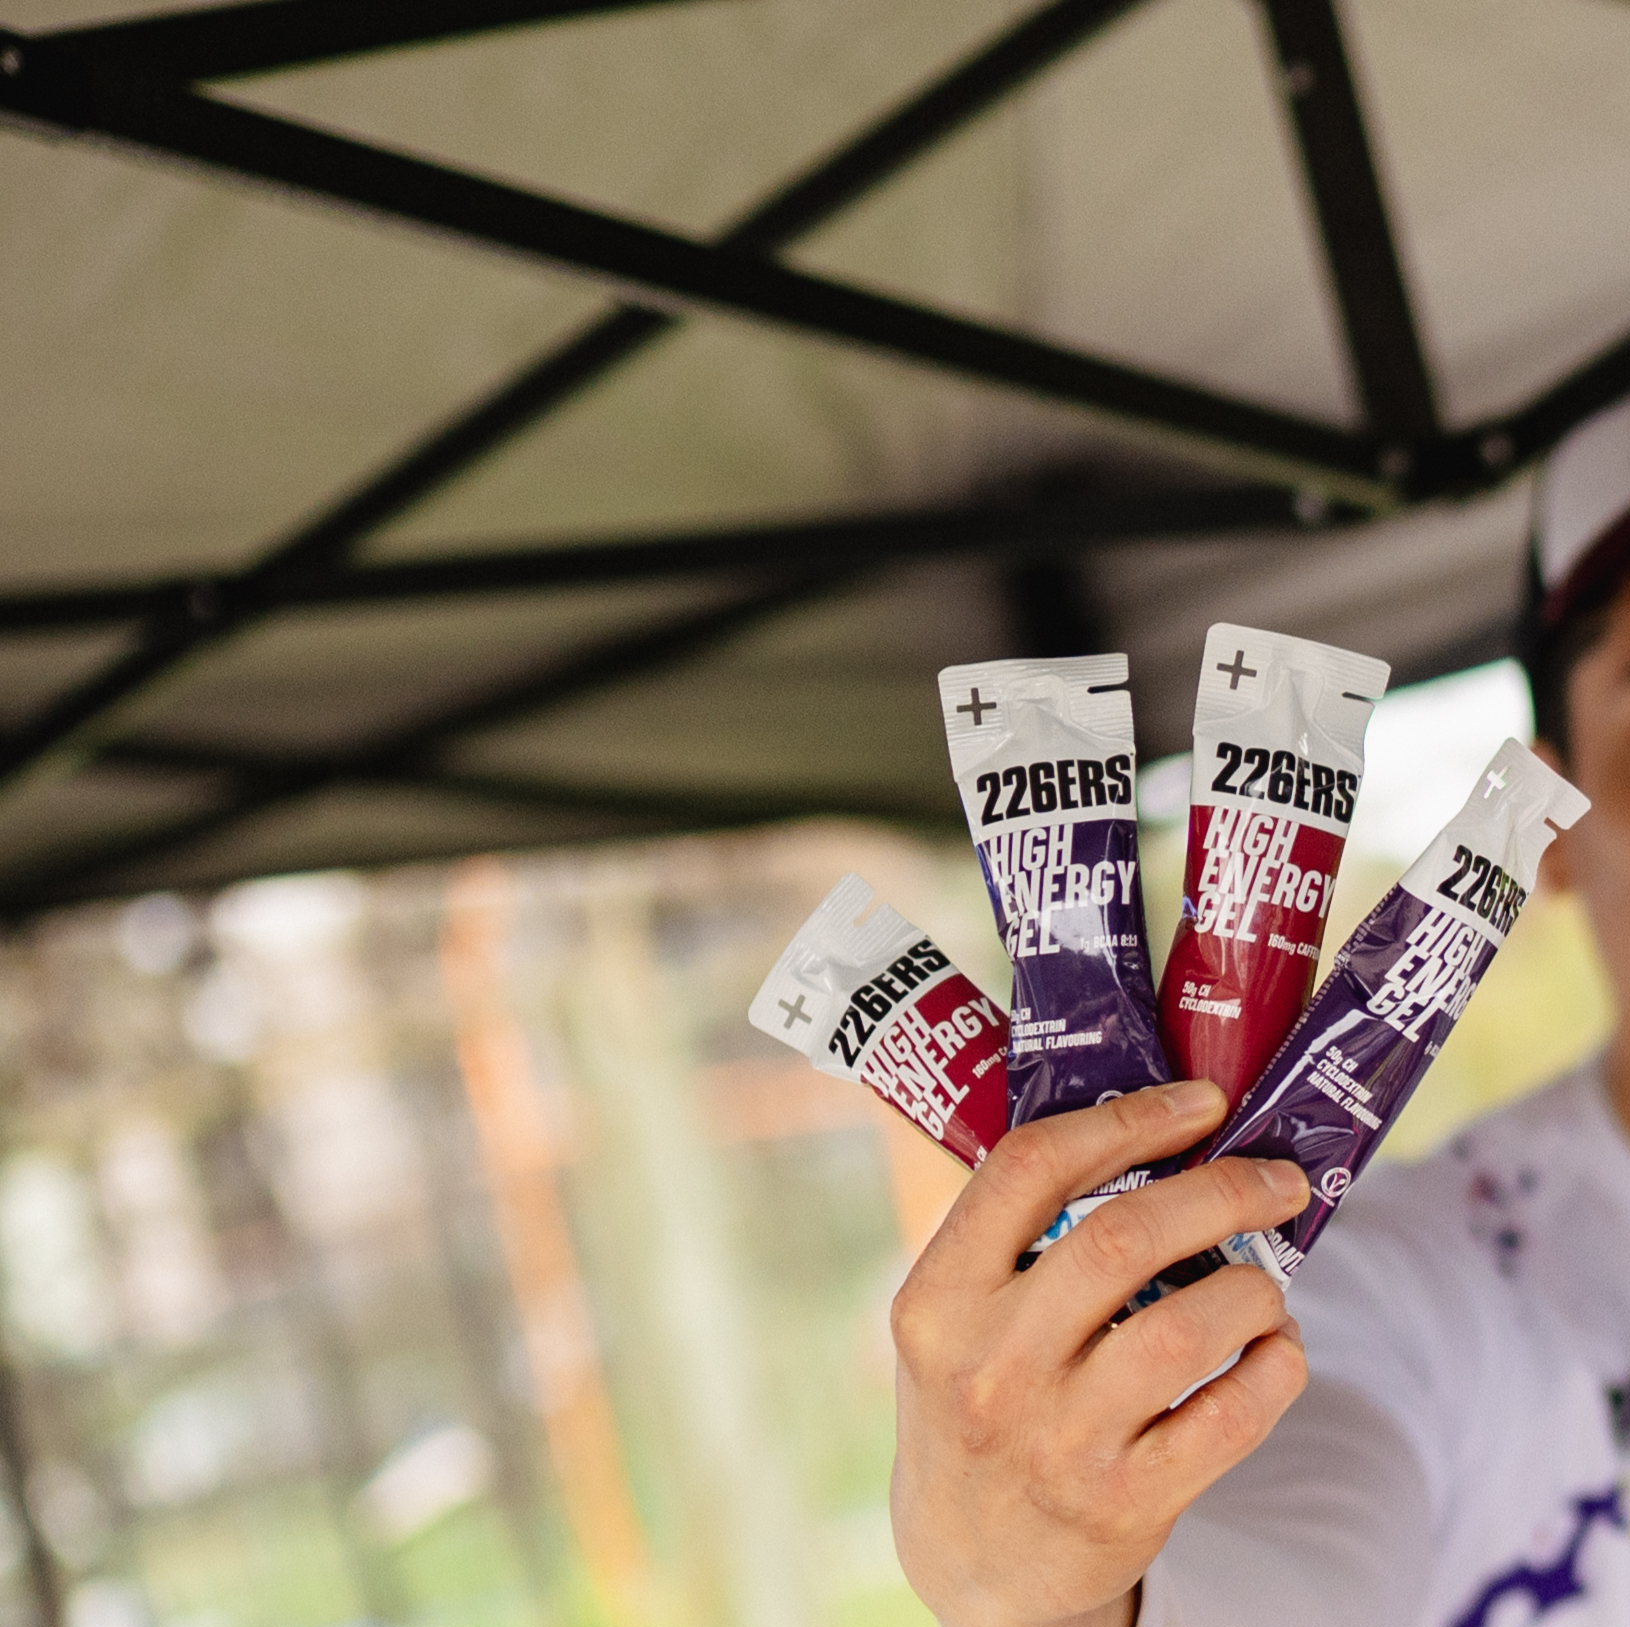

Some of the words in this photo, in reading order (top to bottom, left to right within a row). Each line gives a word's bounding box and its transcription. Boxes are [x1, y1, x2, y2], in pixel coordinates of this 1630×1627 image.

[976, 754, 1132, 826] 226ERS
[1211, 742, 1354, 823] 226ERS
[988, 823, 1073, 882] HIGH
[1203, 806, 1300, 863] HIGH
[999, 861, 1136, 923] ENERGY
[1198, 850, 1337, 918] ENERGY
[1436, 845, 1526, 937] 226ERS
[1006, 908, 1060, 959] GEL
[1093, 935, 1118, 949] BCAA
[1194, 889, 1257, 943] GEL
[1267, 933, 1296, 955] 160mg
[1406, 907, 1487, 975] HIGH
[829, 938, 951, 1068] 226ERS
[1182, 980, 1197, 995] 50g
[1198, 983, 1211, 997] CH
[1384, 943, 1477, 1021] ENERG
[1021, 1007, 1031, 1021] CH
[1045, 1030, 1102, 1050] FLAVOURING
[1366, 981, 1447, 1043] GEL
[862, 1003, 934, 1096] HIGH
[882, 996, 1000, 1121] ENERGY
[972, 1053, 1001, 1079] 160mg
[1325, 1045, 1343, 1066] 50g
[1341, 1057, 1359, 1073] CH
[914, 1083, 970, 1141] GEL
[1306, 1070, 1345, 1104] NATURAL
